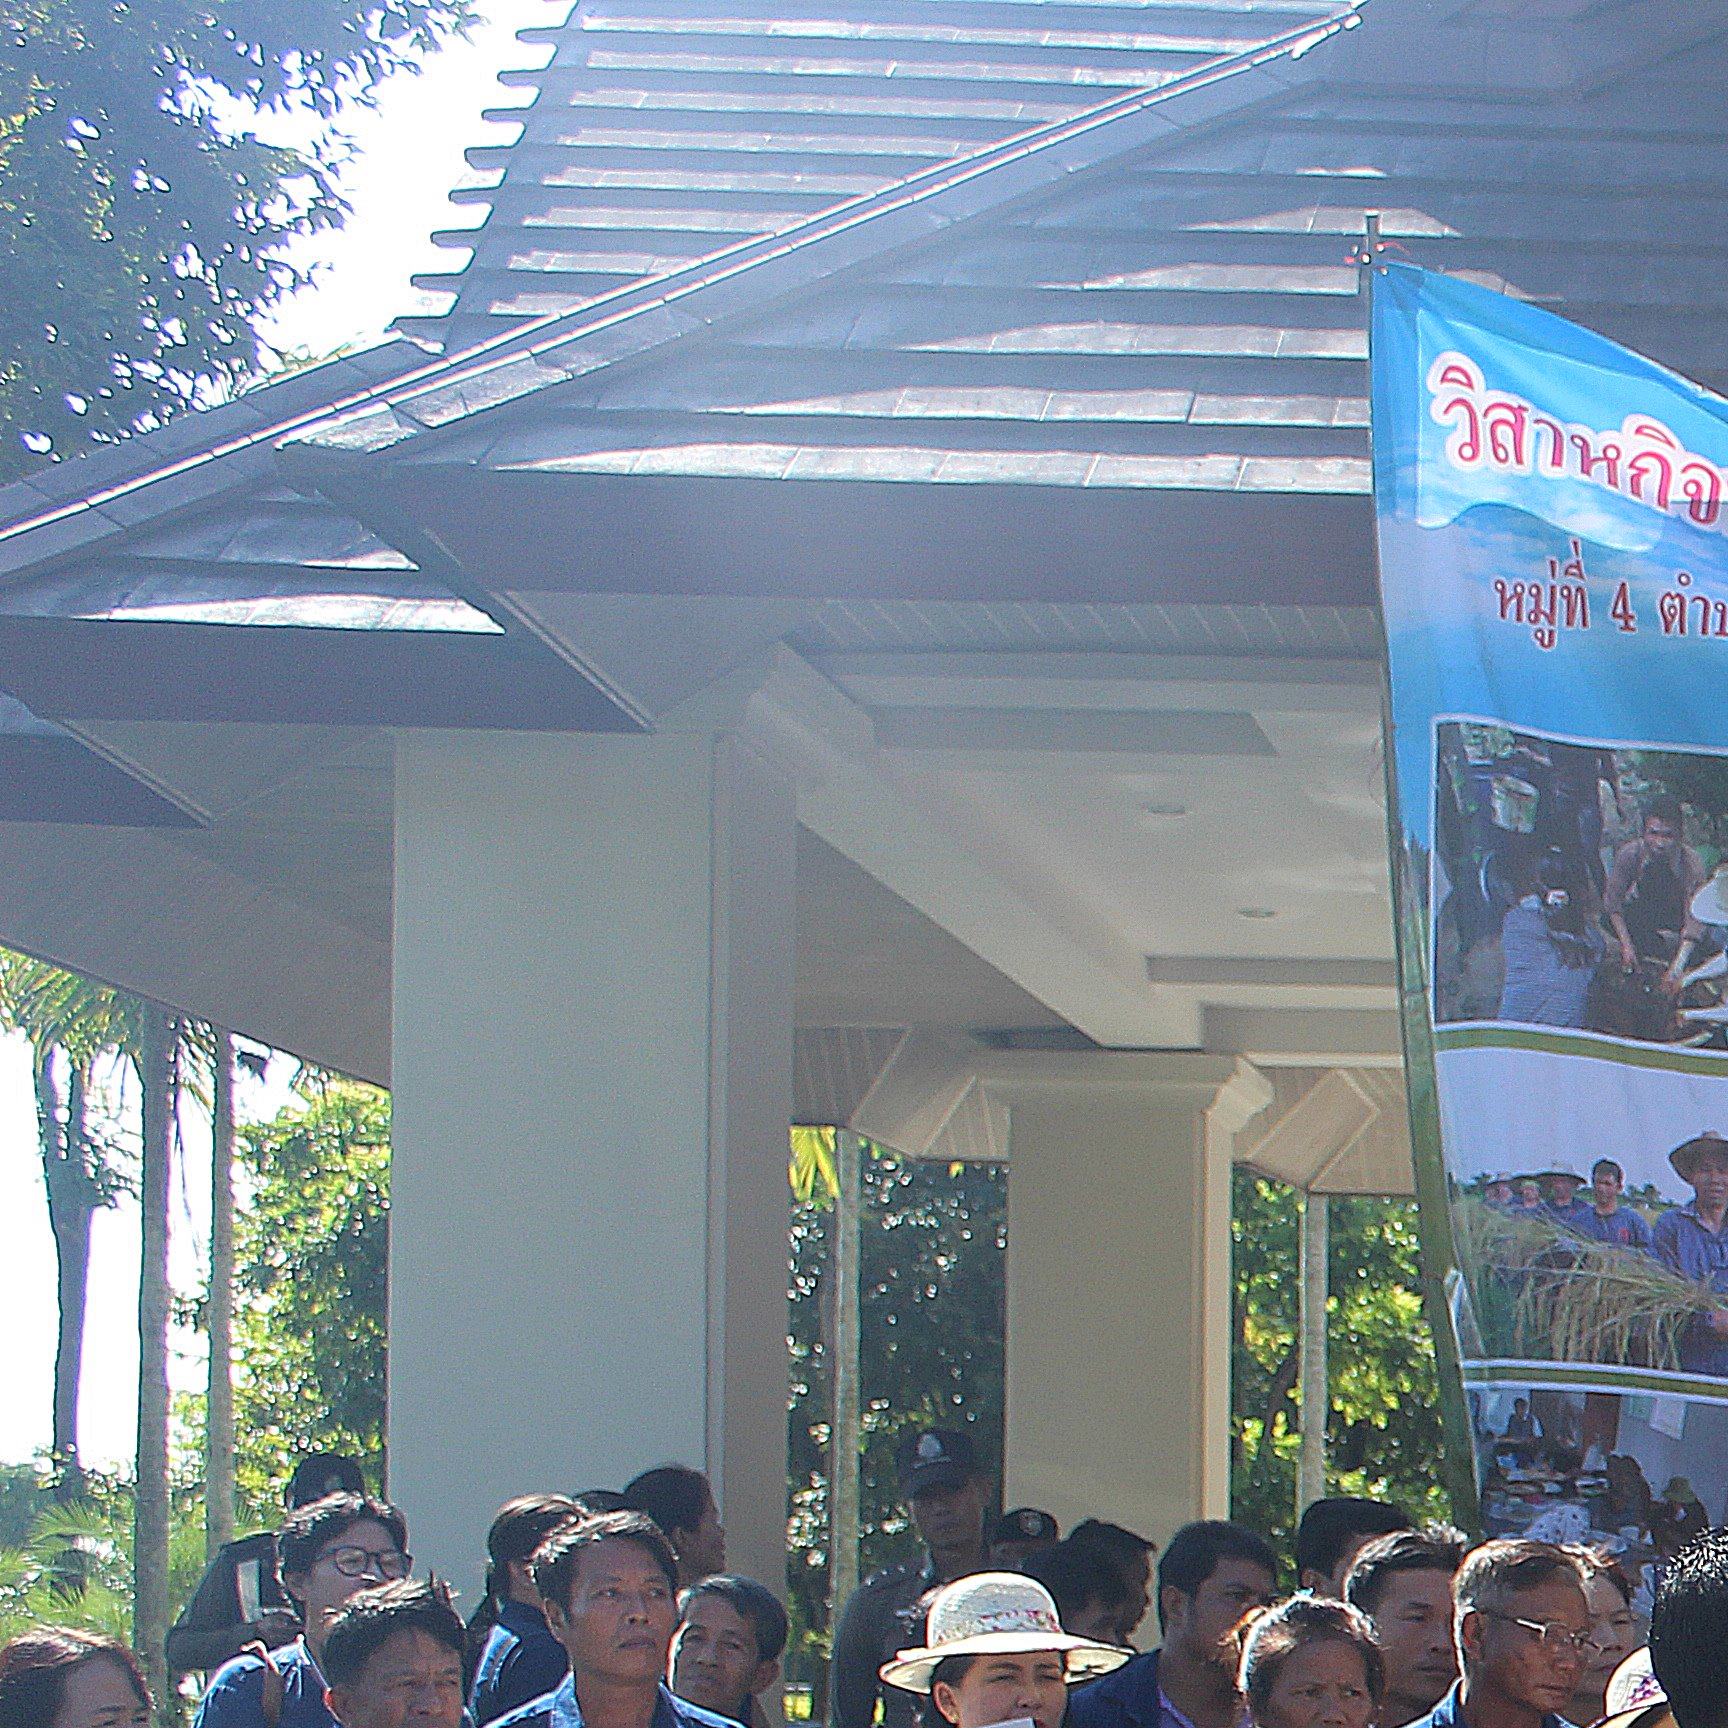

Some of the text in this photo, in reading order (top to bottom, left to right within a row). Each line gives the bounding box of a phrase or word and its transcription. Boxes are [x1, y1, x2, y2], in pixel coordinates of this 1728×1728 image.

[1494, 540, 1590, 648] หมู่ที่
[1611, 582, 1637, 632] 4
